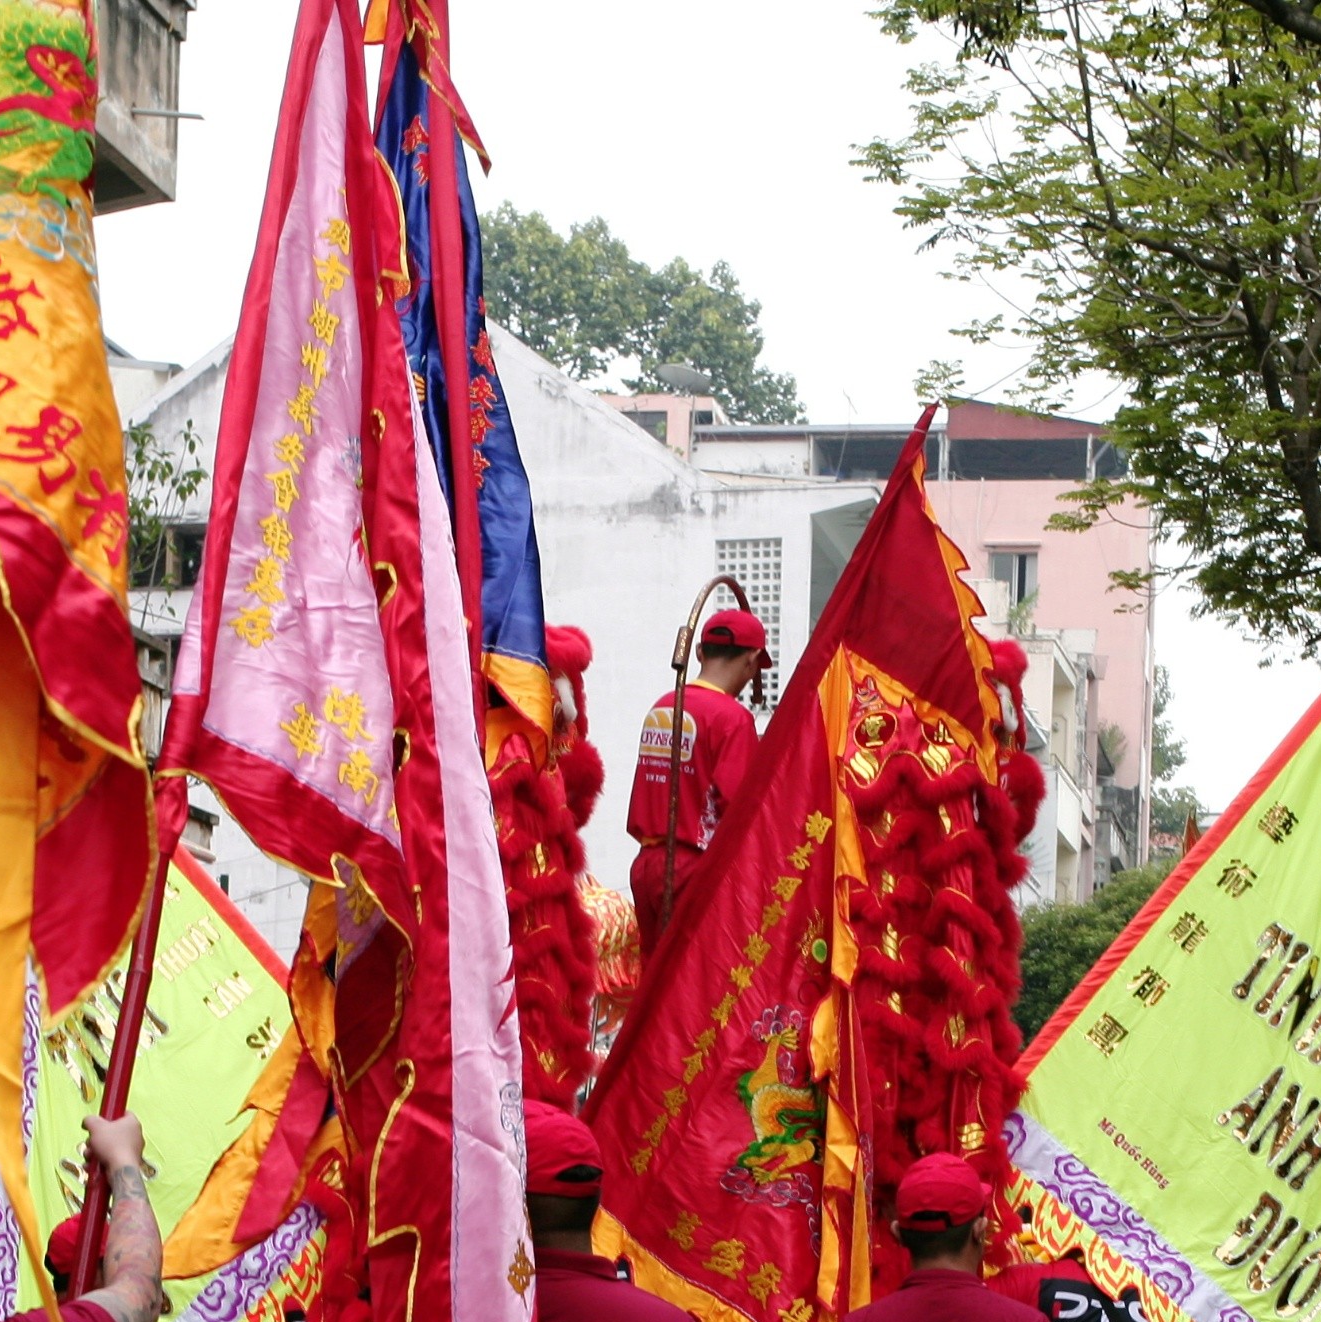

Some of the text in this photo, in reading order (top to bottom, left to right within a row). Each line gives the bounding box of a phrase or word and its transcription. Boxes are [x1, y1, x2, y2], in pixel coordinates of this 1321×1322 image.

[203, 970, 255, 1019] LÂN
[1113, 1131, 1144, 1163] Quốc
[1140, 1153, 1171, 1192] Hùng
